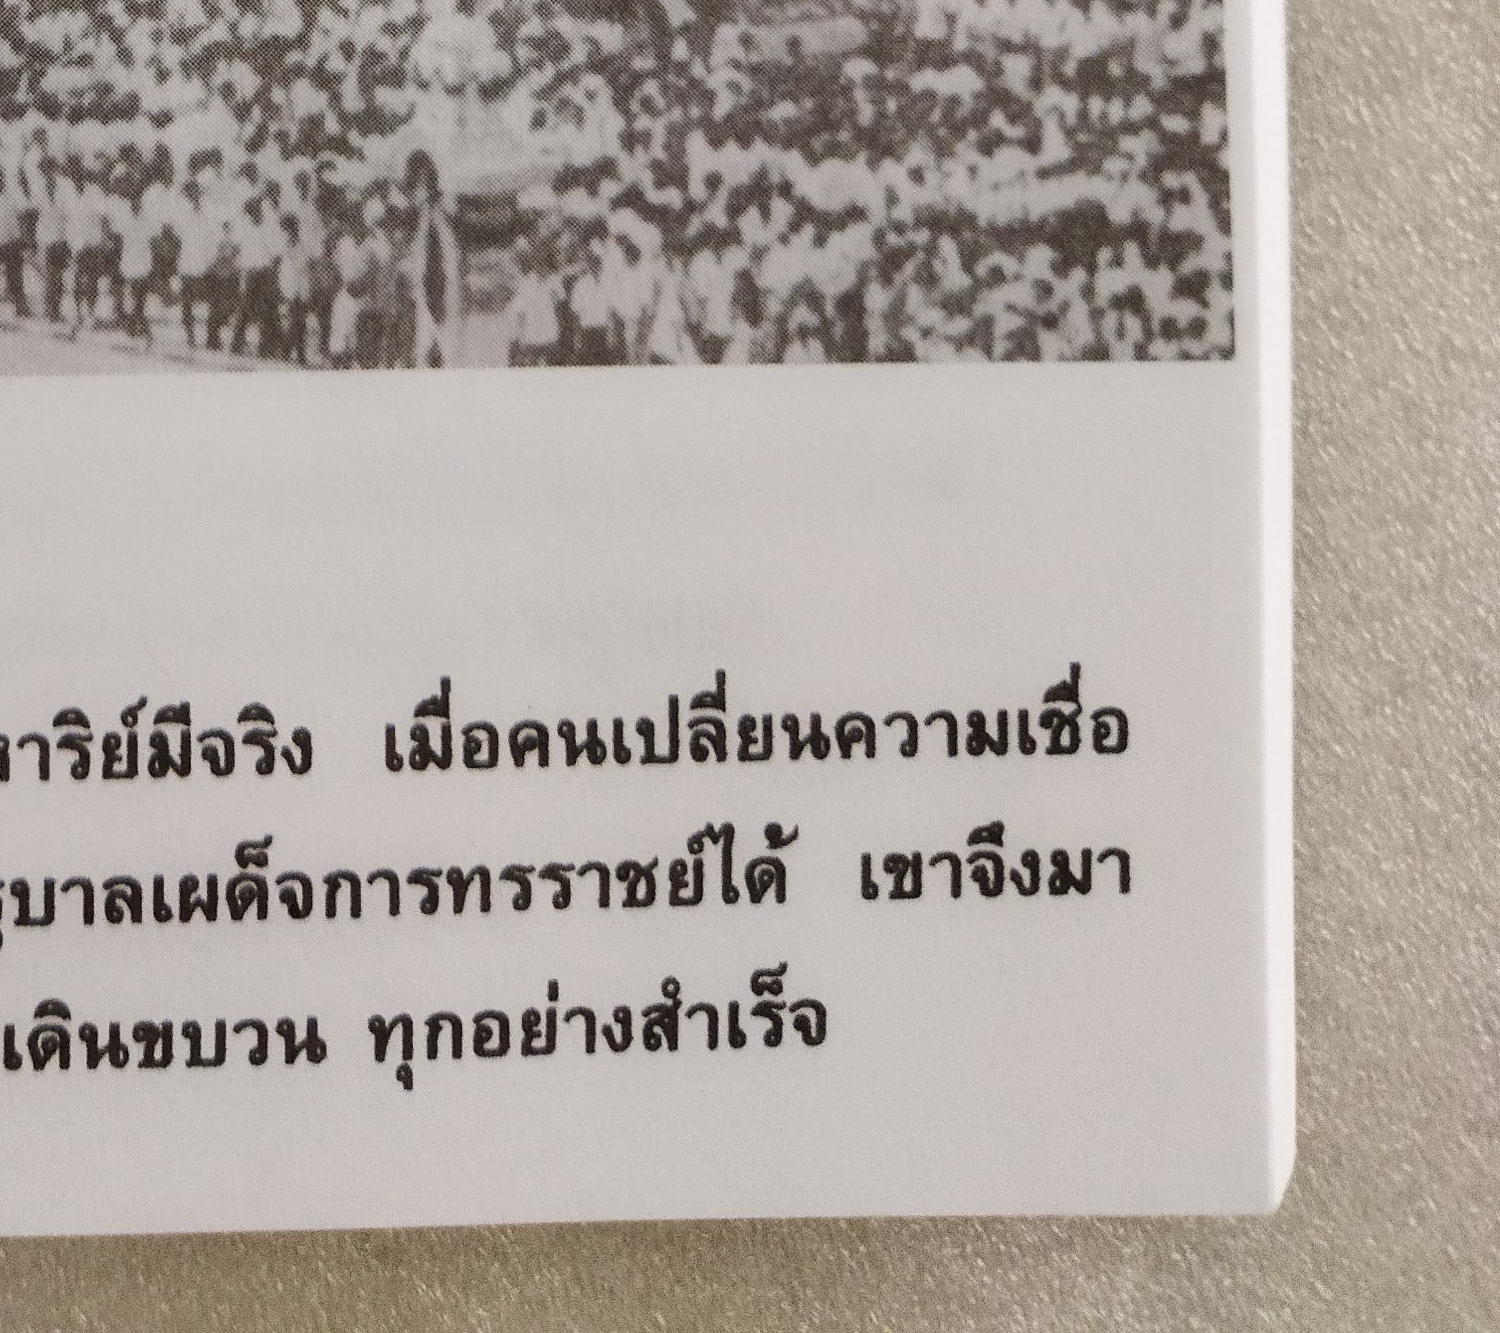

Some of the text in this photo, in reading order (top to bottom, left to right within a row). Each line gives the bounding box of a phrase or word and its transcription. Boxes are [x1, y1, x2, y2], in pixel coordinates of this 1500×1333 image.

[383, 660, 1130, 774] เมื่อคนเปลี่ยนความเชื่อ
[859, 819, 1133, 902] เขาจึงมา
[366, 960, 828, 1093] ทุกอย่างสำเร็จ
